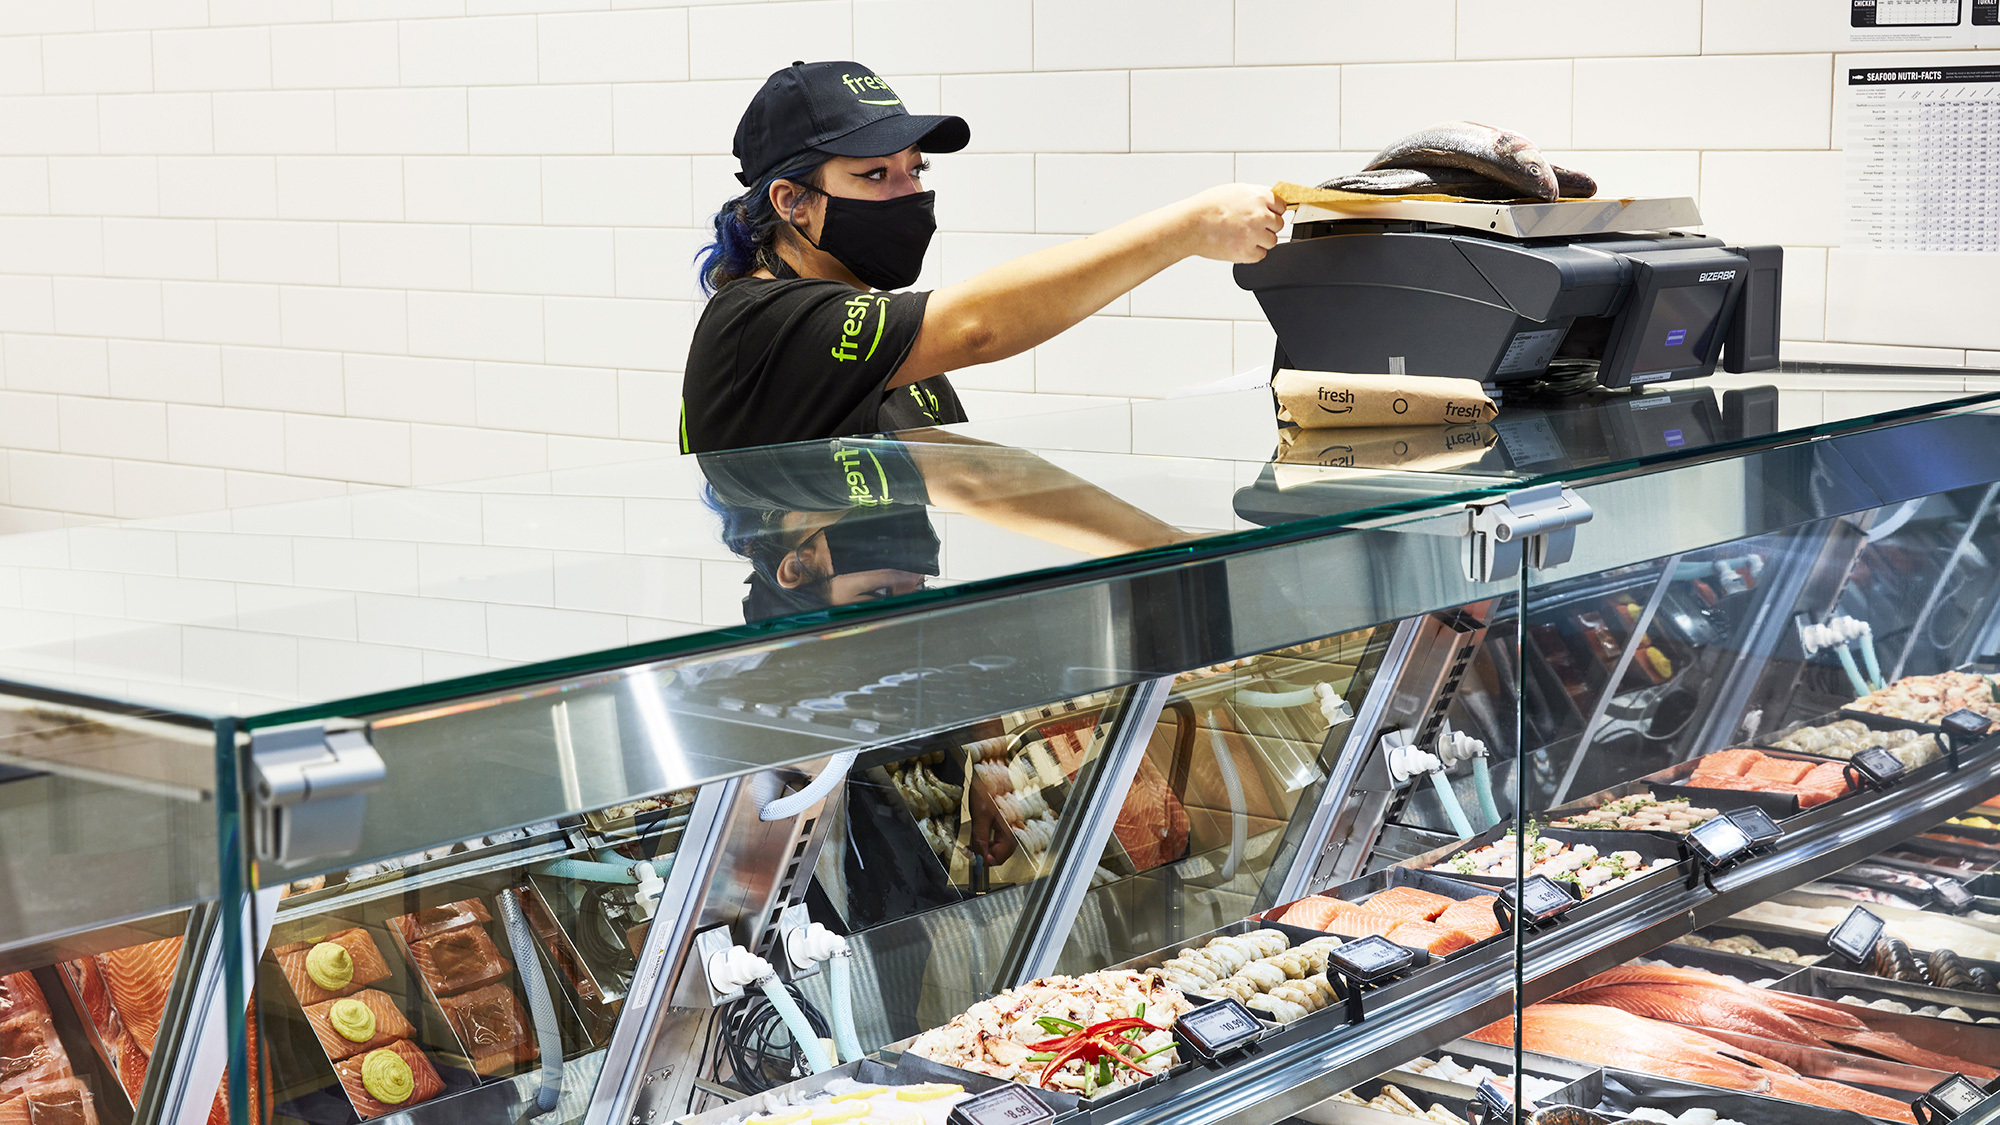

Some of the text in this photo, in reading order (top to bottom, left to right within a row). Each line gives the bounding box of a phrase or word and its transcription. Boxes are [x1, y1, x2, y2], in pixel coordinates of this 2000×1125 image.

[842, 73, 894, 95] fres
[1866, 72, 1897, 82] SEAFOOD
[1897, 71, 1942, 81] NUTRI-FACTS
[1698, 270, 1736, 282] BIZERBA
[831, 293, 875, 363] fresh
[1318, 387, 1355, 404] fresh
[1445, 402, 1481, 419] fresh
[1219, 1018, 1245, 1032] $10.99
[1003, 1104, 1032, 1119] $8.99
